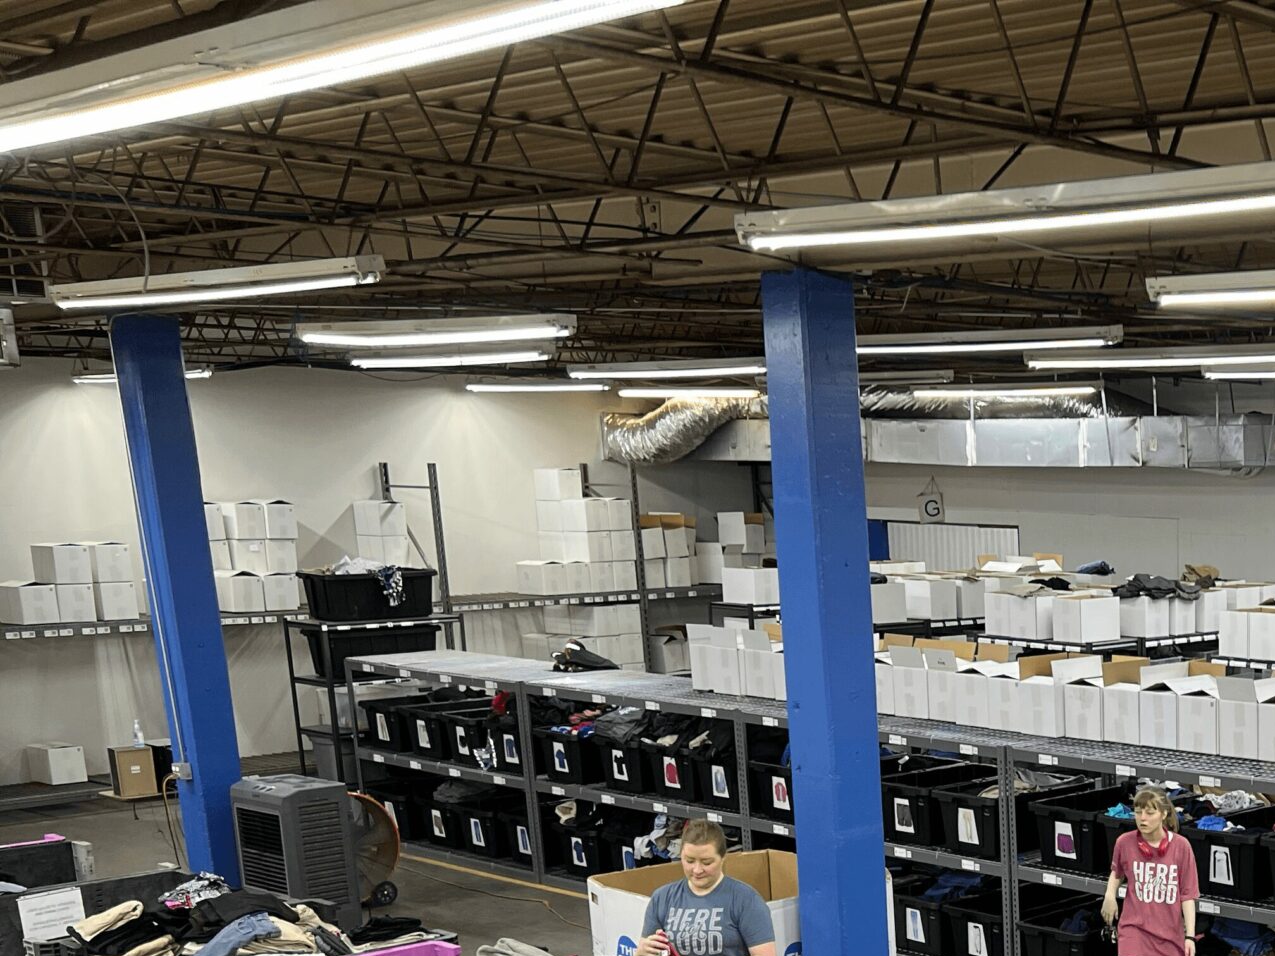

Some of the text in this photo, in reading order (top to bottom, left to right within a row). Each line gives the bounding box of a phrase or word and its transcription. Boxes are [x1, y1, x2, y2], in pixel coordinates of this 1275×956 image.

[925, 500, 940, 517] G
[1133, 861, 1178, 885] HERE
[1135, 882, 1178, 905] GOOD
[666, 907, 724, 932] HERE
